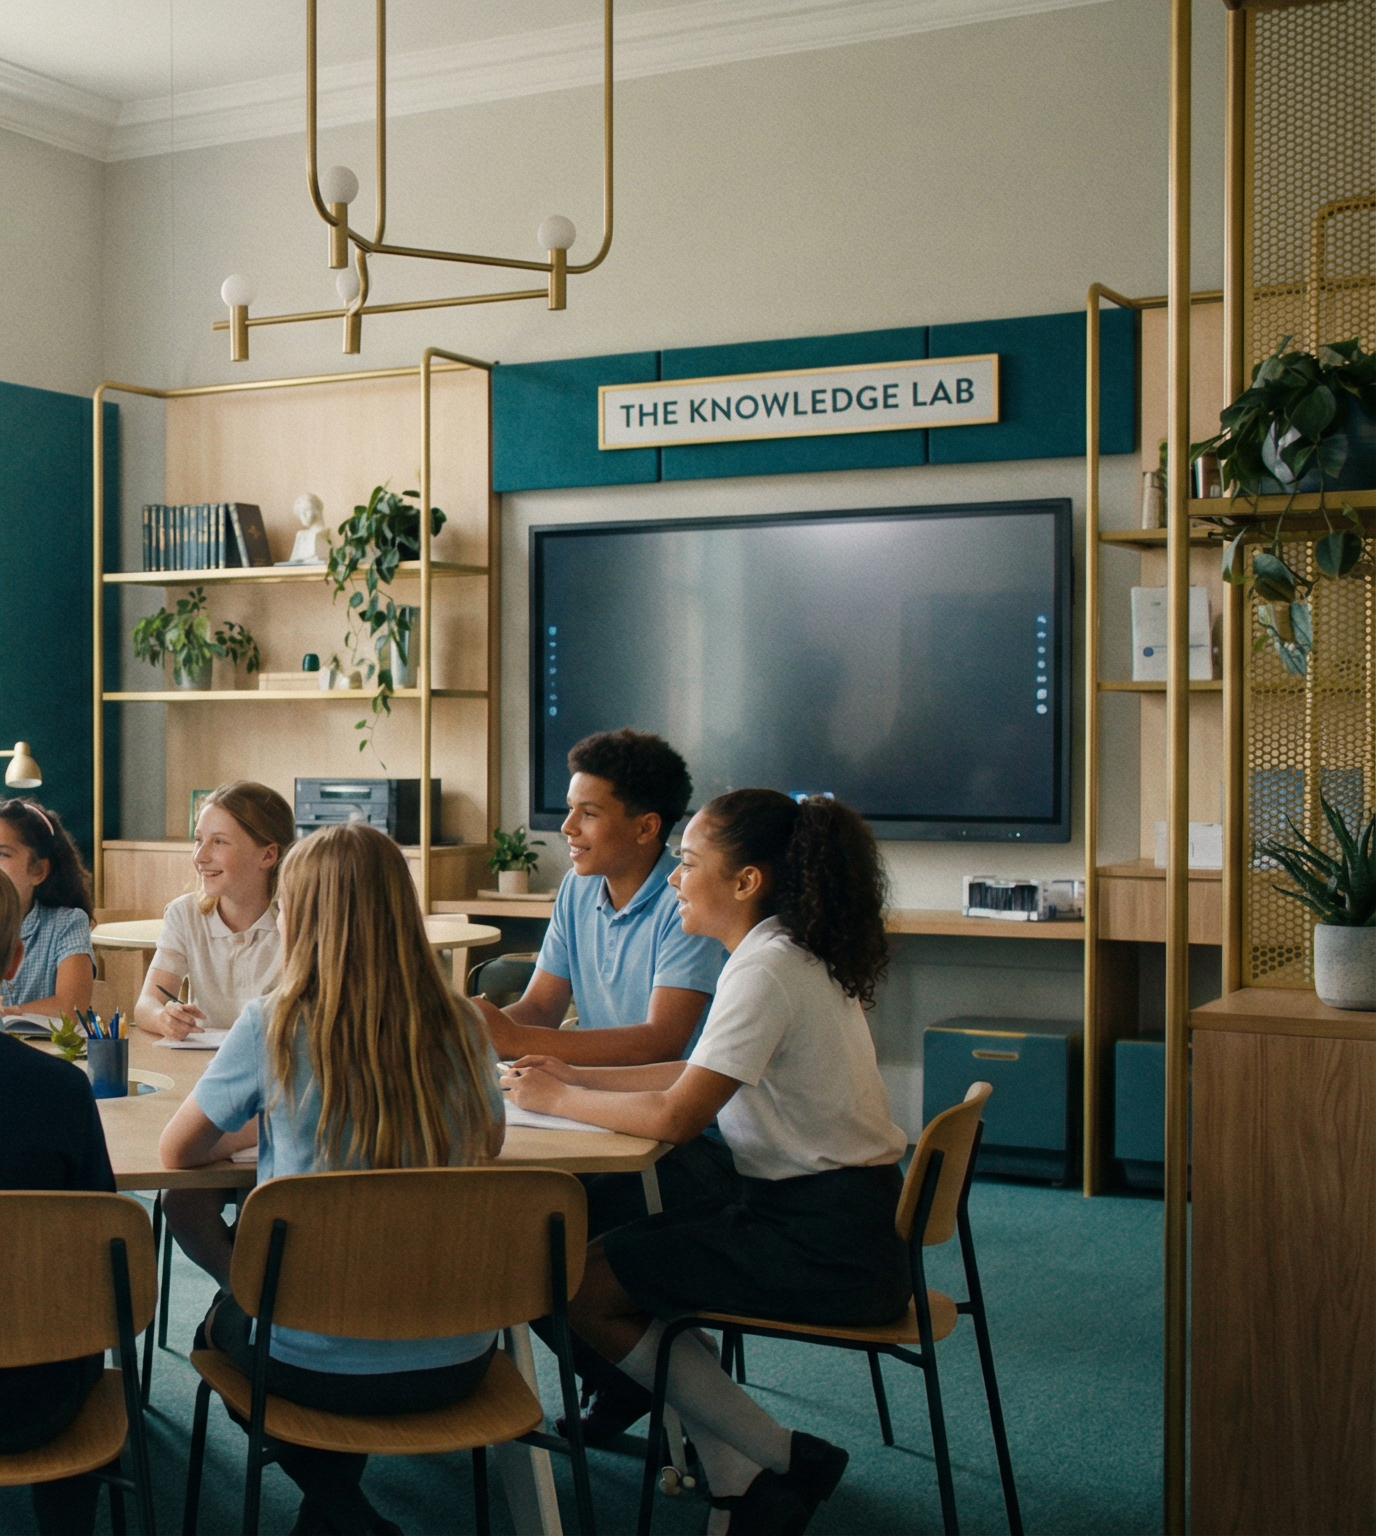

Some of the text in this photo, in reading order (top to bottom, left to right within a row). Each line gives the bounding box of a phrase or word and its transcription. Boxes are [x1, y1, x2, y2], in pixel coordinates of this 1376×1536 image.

[620, 377, 975, 428] THE KNOWLEDGE LAB
